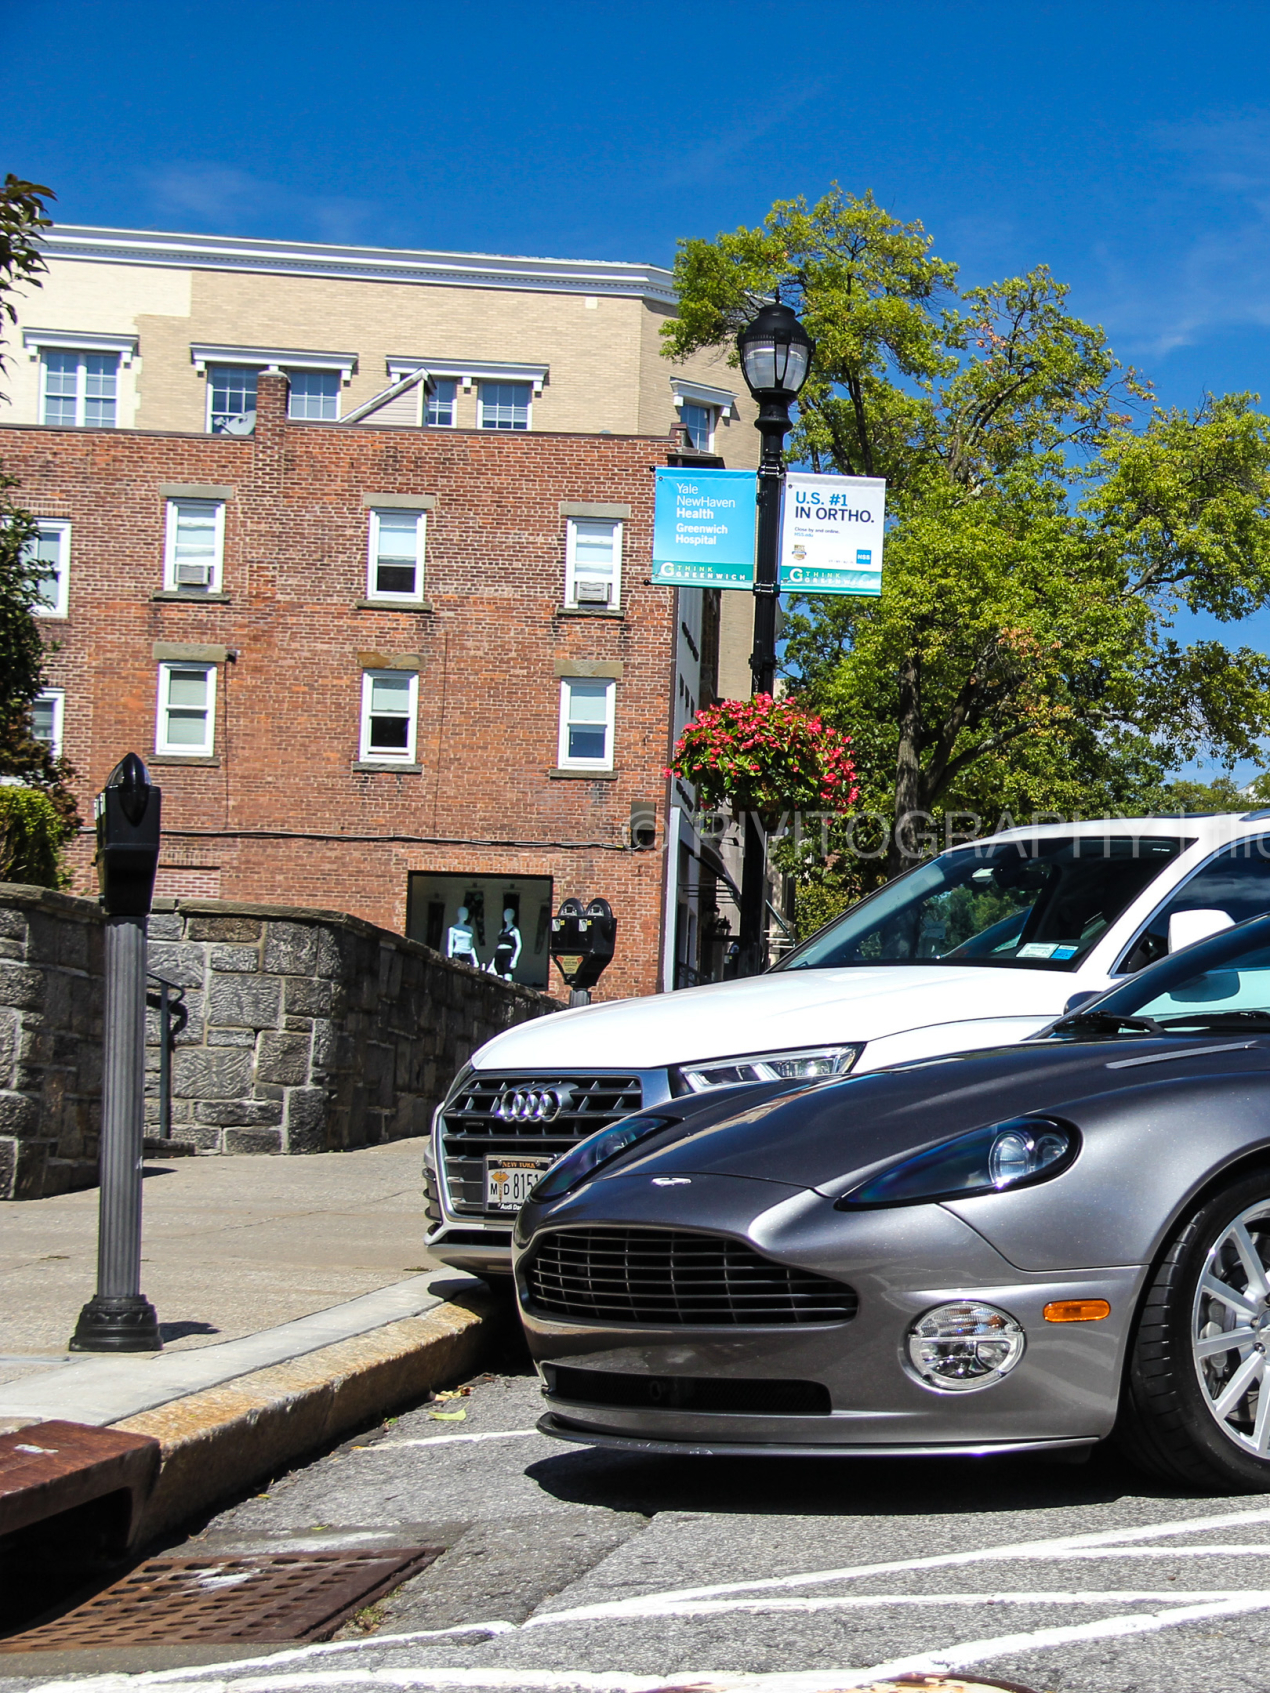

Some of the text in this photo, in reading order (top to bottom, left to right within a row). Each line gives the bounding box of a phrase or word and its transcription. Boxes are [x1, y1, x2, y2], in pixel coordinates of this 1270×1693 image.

[676, 483, 698, 494] Yale
[676, 495, 736, 508] NewHaven
[795, 491, 848, 507] U.S. #1
[676, 507, 714, 519] Health
[795, 506, 875, 523] IN ORTHO.
[676, 523, 728, 534] Greenwich
[675, 534, 717, 546] Hospital
[676, 571, 746, 580] GREENWICH
[806, 570, 841, 578] THINK
